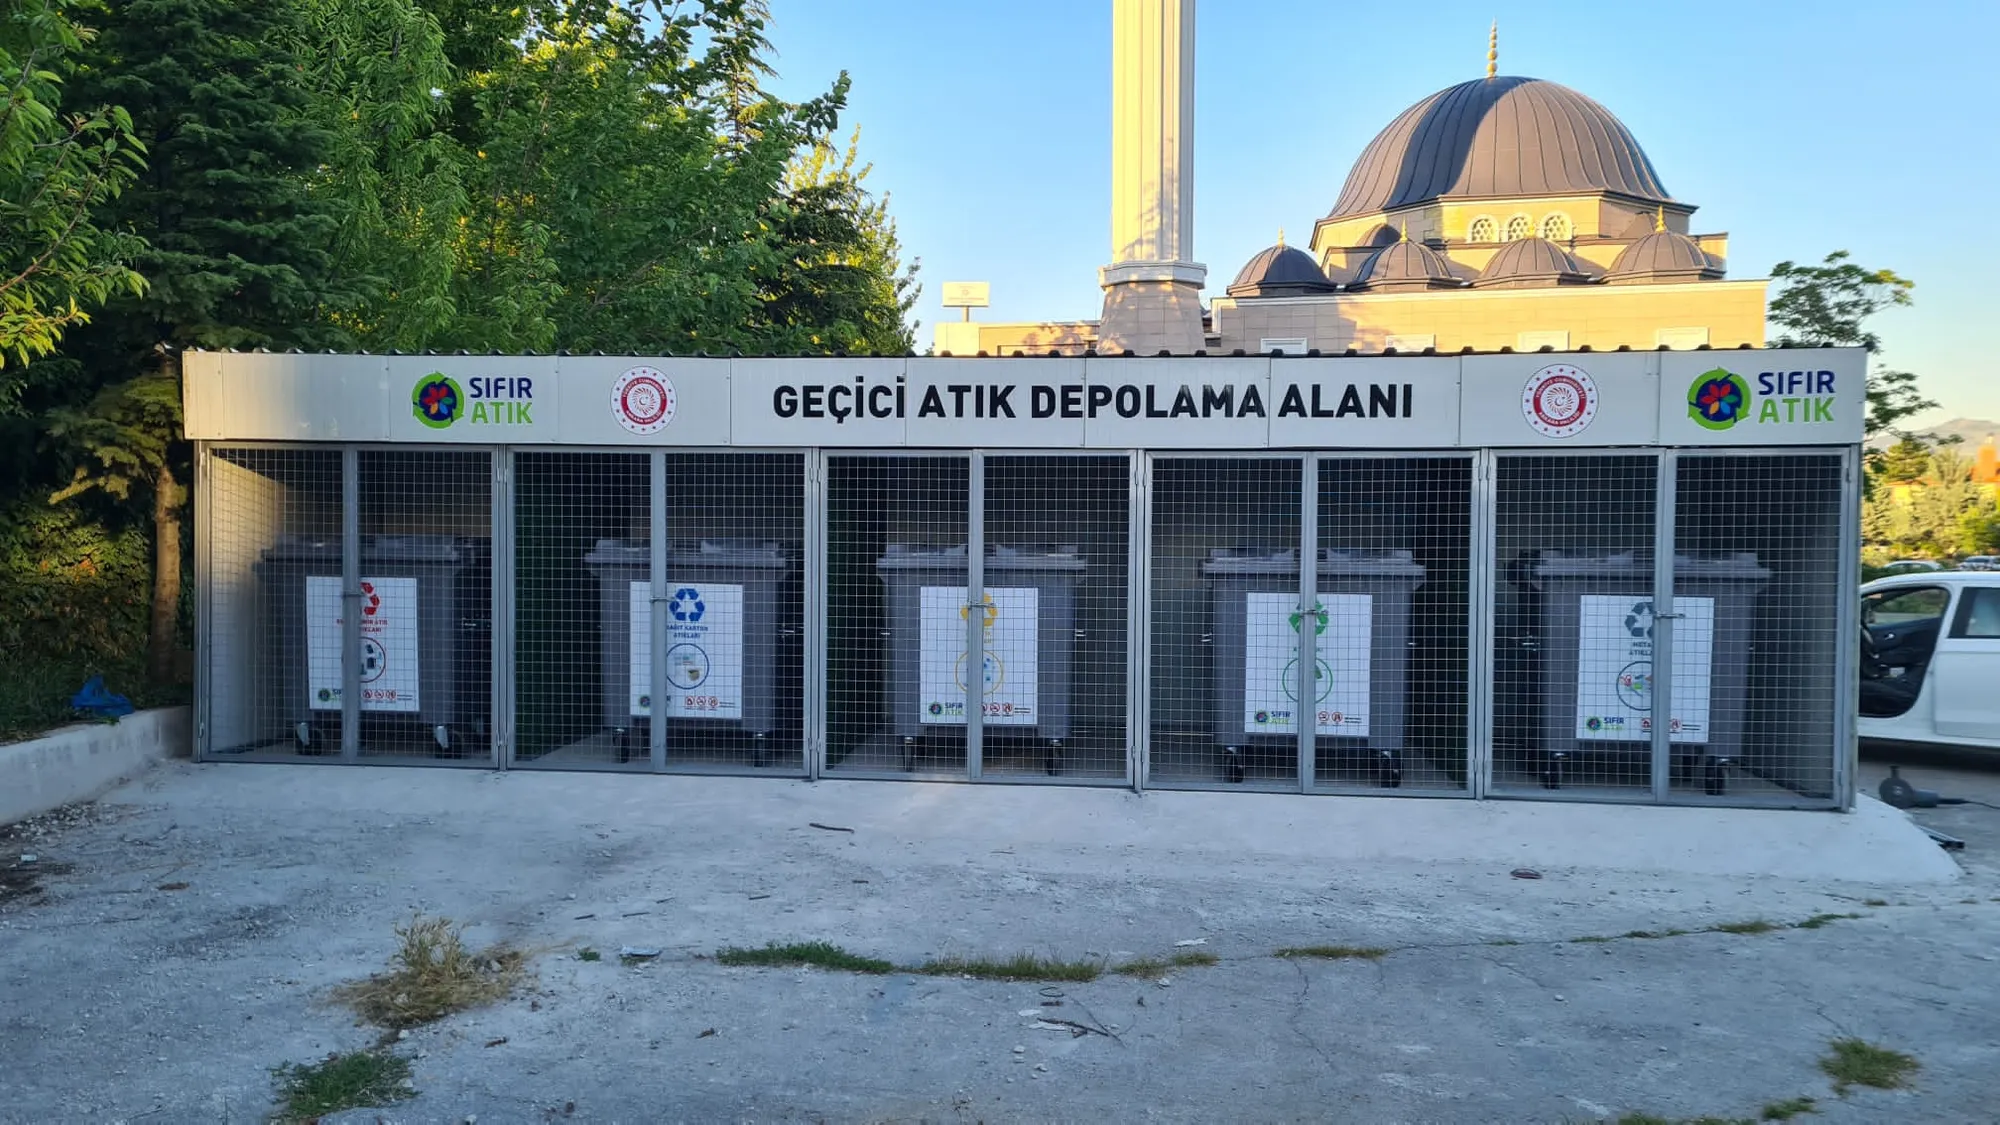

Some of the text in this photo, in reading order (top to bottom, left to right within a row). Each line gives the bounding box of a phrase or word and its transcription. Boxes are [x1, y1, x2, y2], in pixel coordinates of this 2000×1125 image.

[469, 377, 532, 398] SIFIR
[1758, 370, 1836, 395] SIFIR
[773, 375, 1413, 424] GEÇİCİ ATIK DEPOLAMA ALANI
[1758, 397, 1836, 424] ATIK
[471, 402, 533, 424] ATIK
